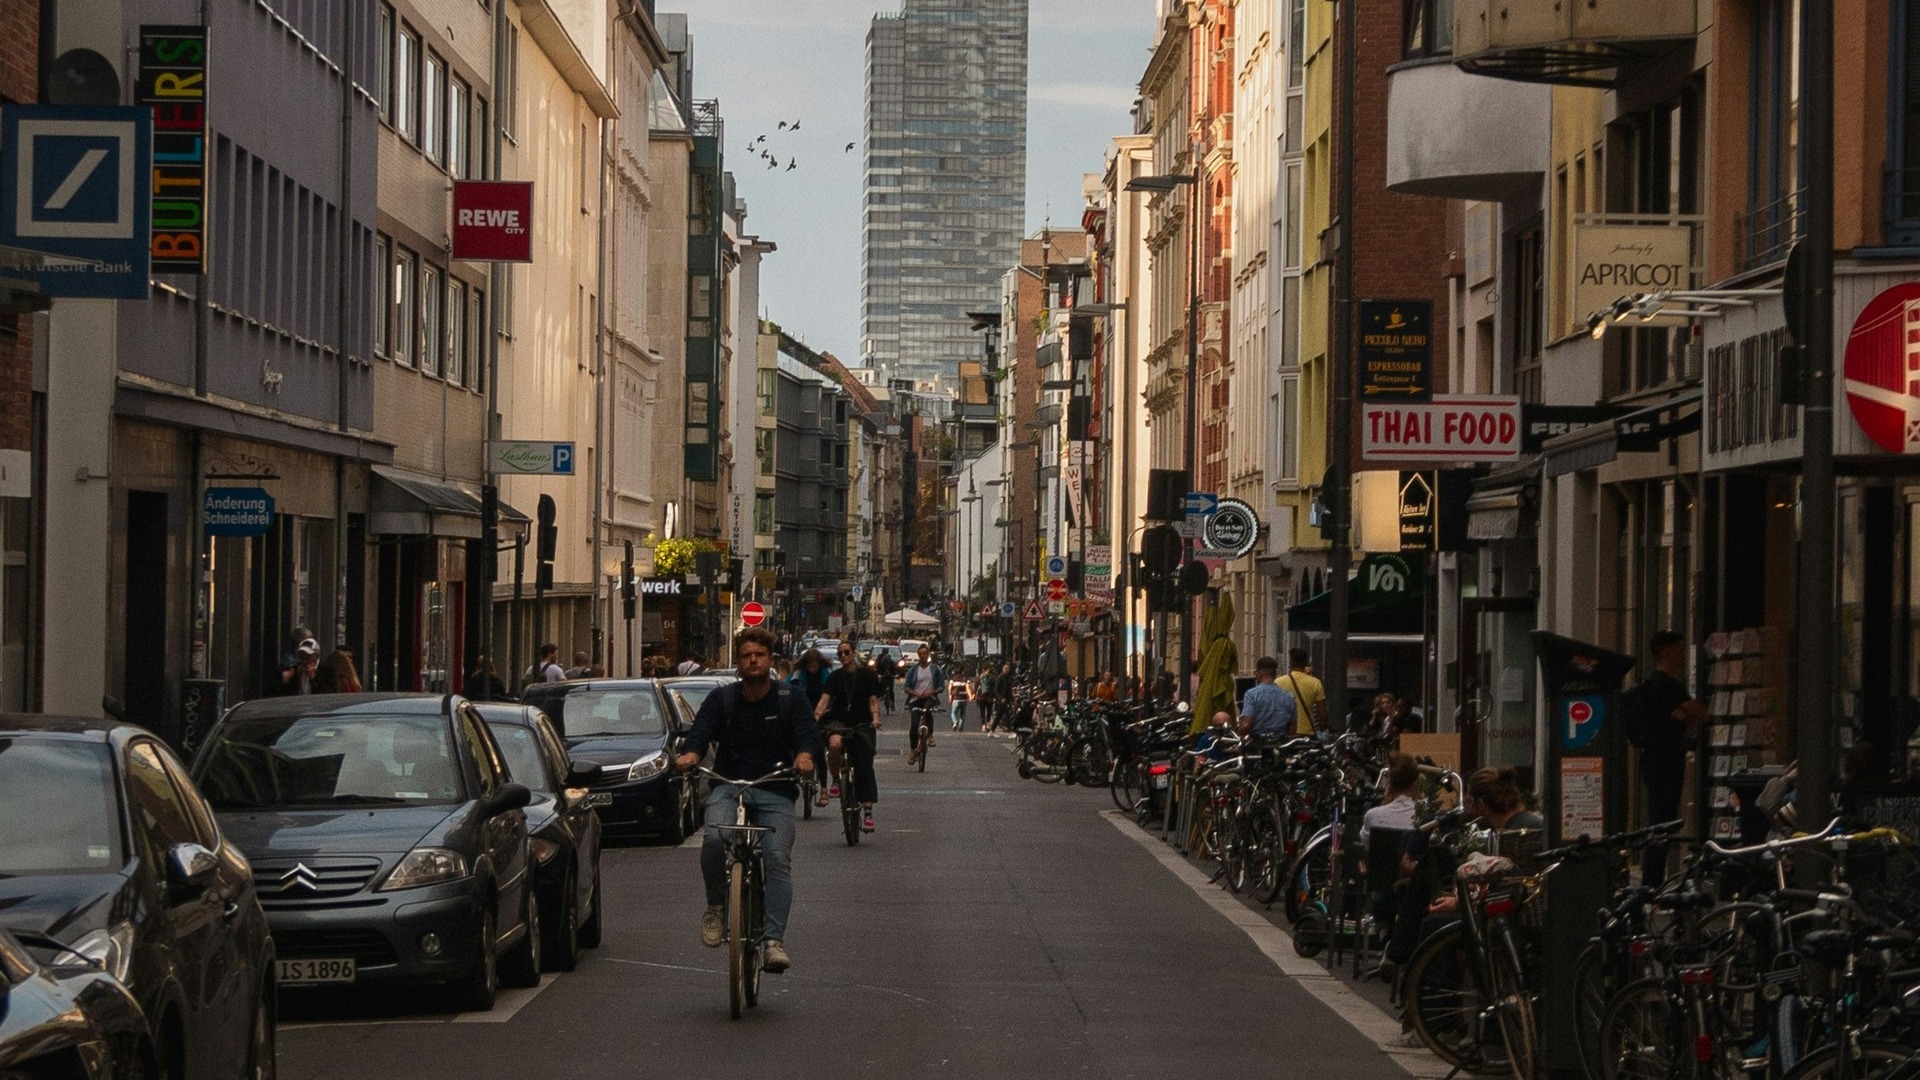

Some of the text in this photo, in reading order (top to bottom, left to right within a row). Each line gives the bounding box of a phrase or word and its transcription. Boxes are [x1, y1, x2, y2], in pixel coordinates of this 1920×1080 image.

[152, 39, 204, 259] BUTLERS
[459, 209, 520, 227] REWE
[15, 260, 132, 273] utsche Bank
[1580, 263, 1682, 286] APRICOT
[1401, 335, 1427, 346] NERO
[1368, 361, 1423, 372] ESPRESSOBAR
[1367, 410, 1516, 445] THAI FOOD
[1530, 422, 1650, 437] FREAG
[557, 449, 570, 468] P
[205, 493, 266, 513] Änderung
[203, 511, 270, 525] Schneiderei
[641, 579, 681, 595] werk
[281, 960, 353, 980] IS 1896
